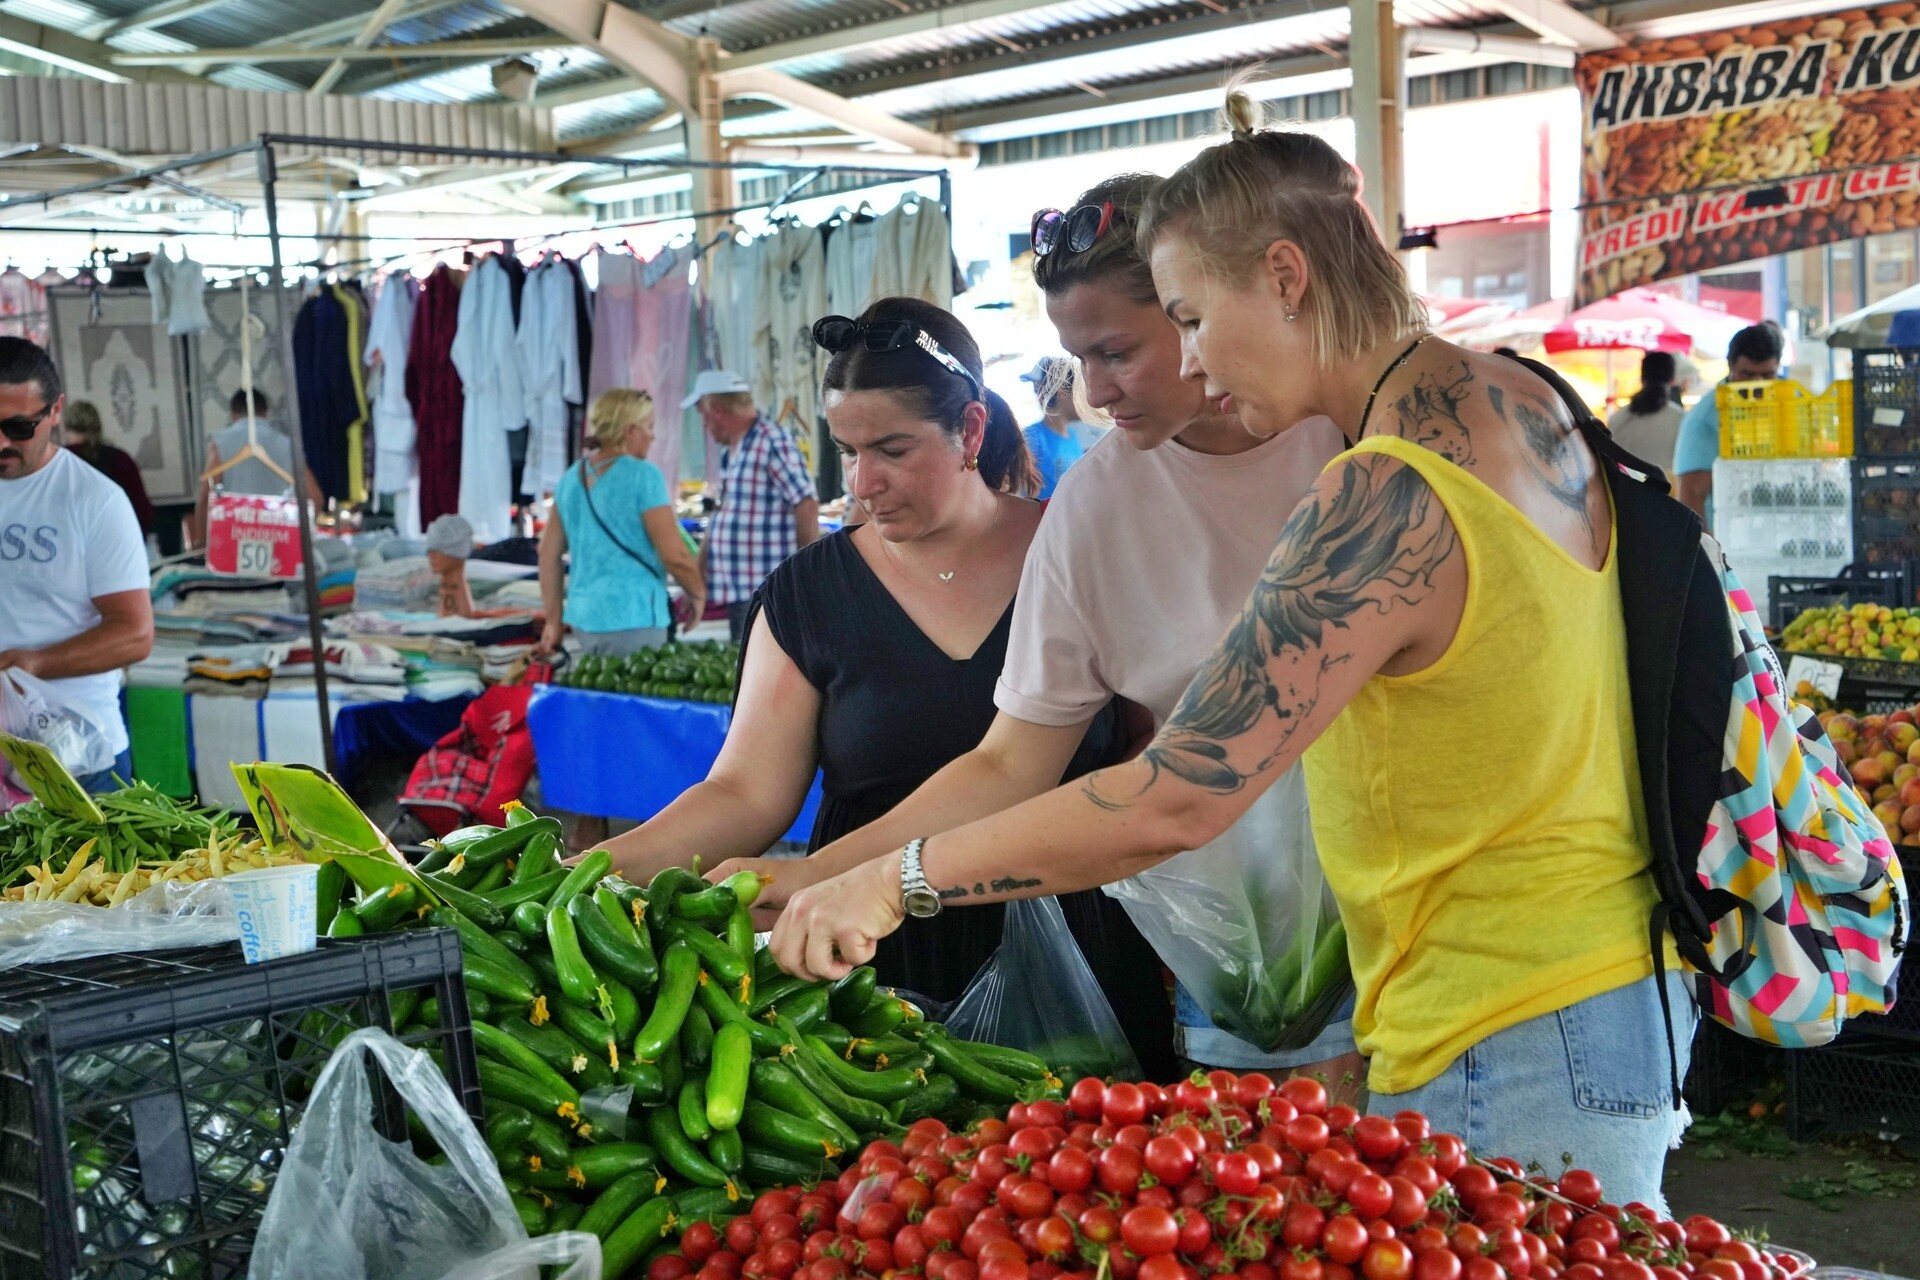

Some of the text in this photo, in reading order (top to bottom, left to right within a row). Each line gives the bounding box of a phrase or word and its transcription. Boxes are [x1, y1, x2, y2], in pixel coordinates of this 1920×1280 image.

[1592, 43, 1827, 130] AKBABA
[1697, 177, 1834, 227] KATI
[1849, 162, 1920, 196] GE
[0, 523, 59, 563] SS
[241, 542, 268, 572] 50
